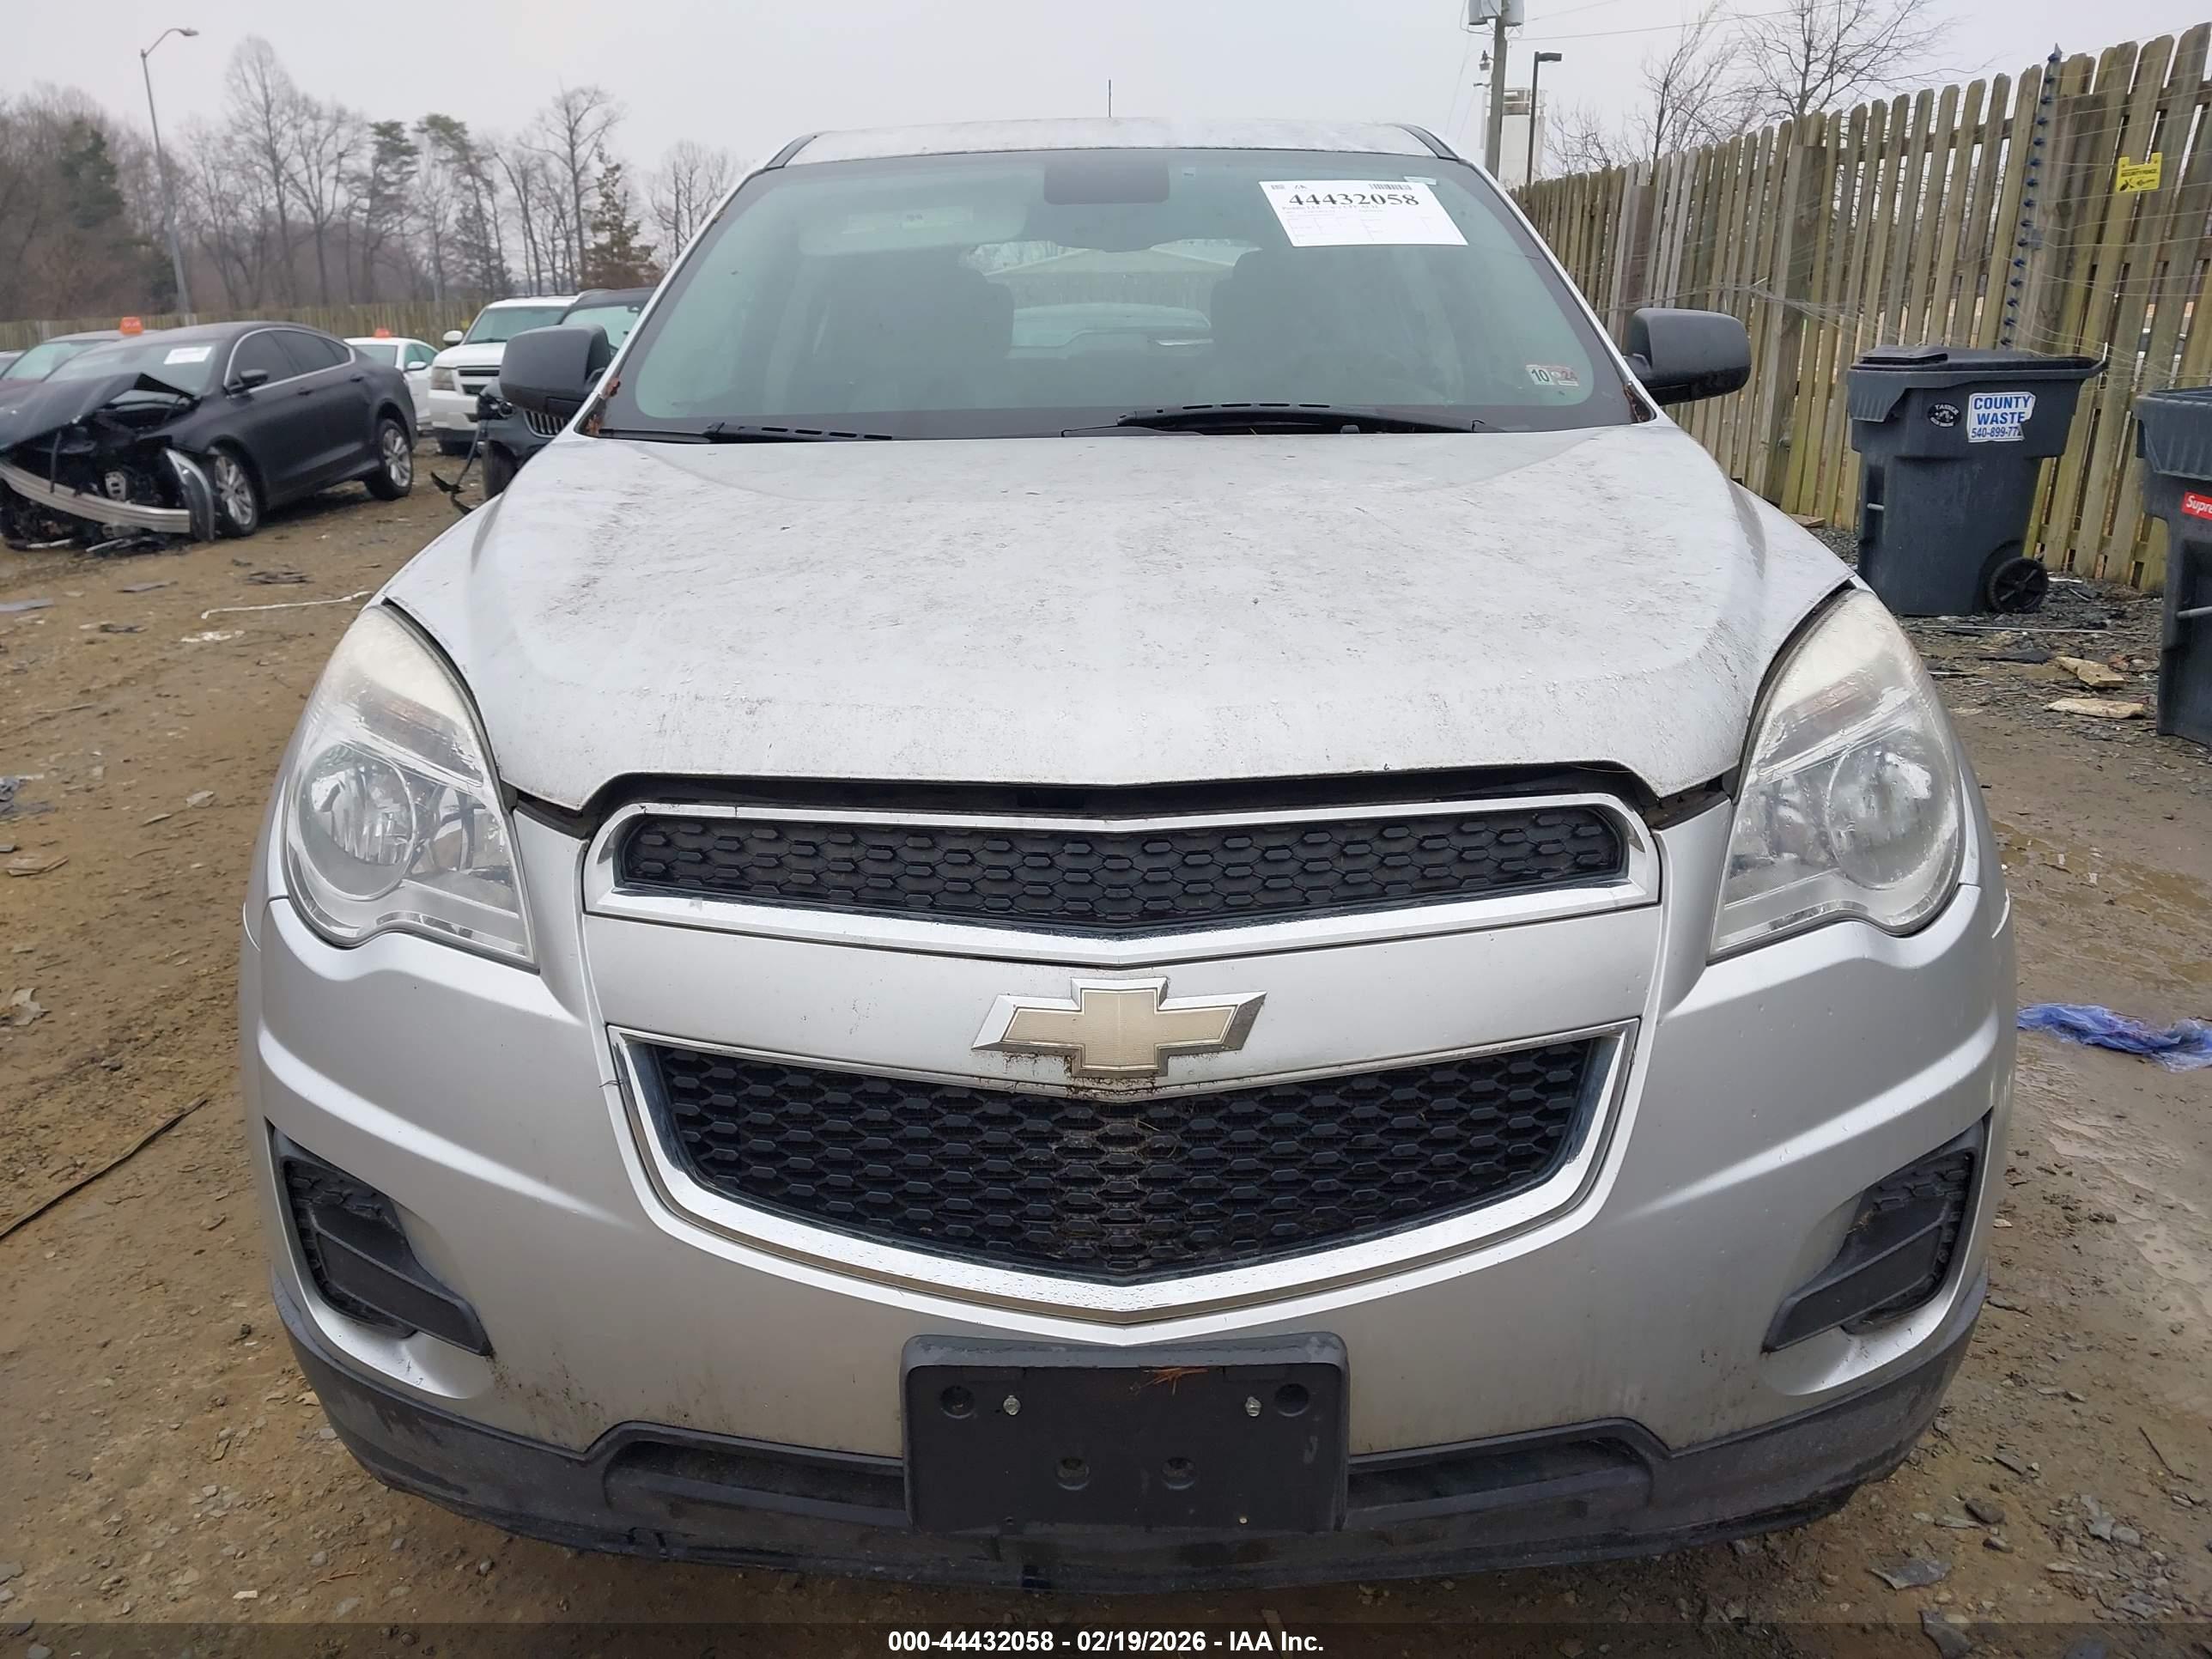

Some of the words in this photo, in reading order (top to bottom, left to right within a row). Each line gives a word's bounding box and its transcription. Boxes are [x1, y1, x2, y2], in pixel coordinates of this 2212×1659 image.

[1289, 193, 1419, 206] 44432058
[1532, 369, 1550, 382] 10
[1974, 396, 2032, 410] COUNTY
[1977, 412, 2025, 425] WASTE
